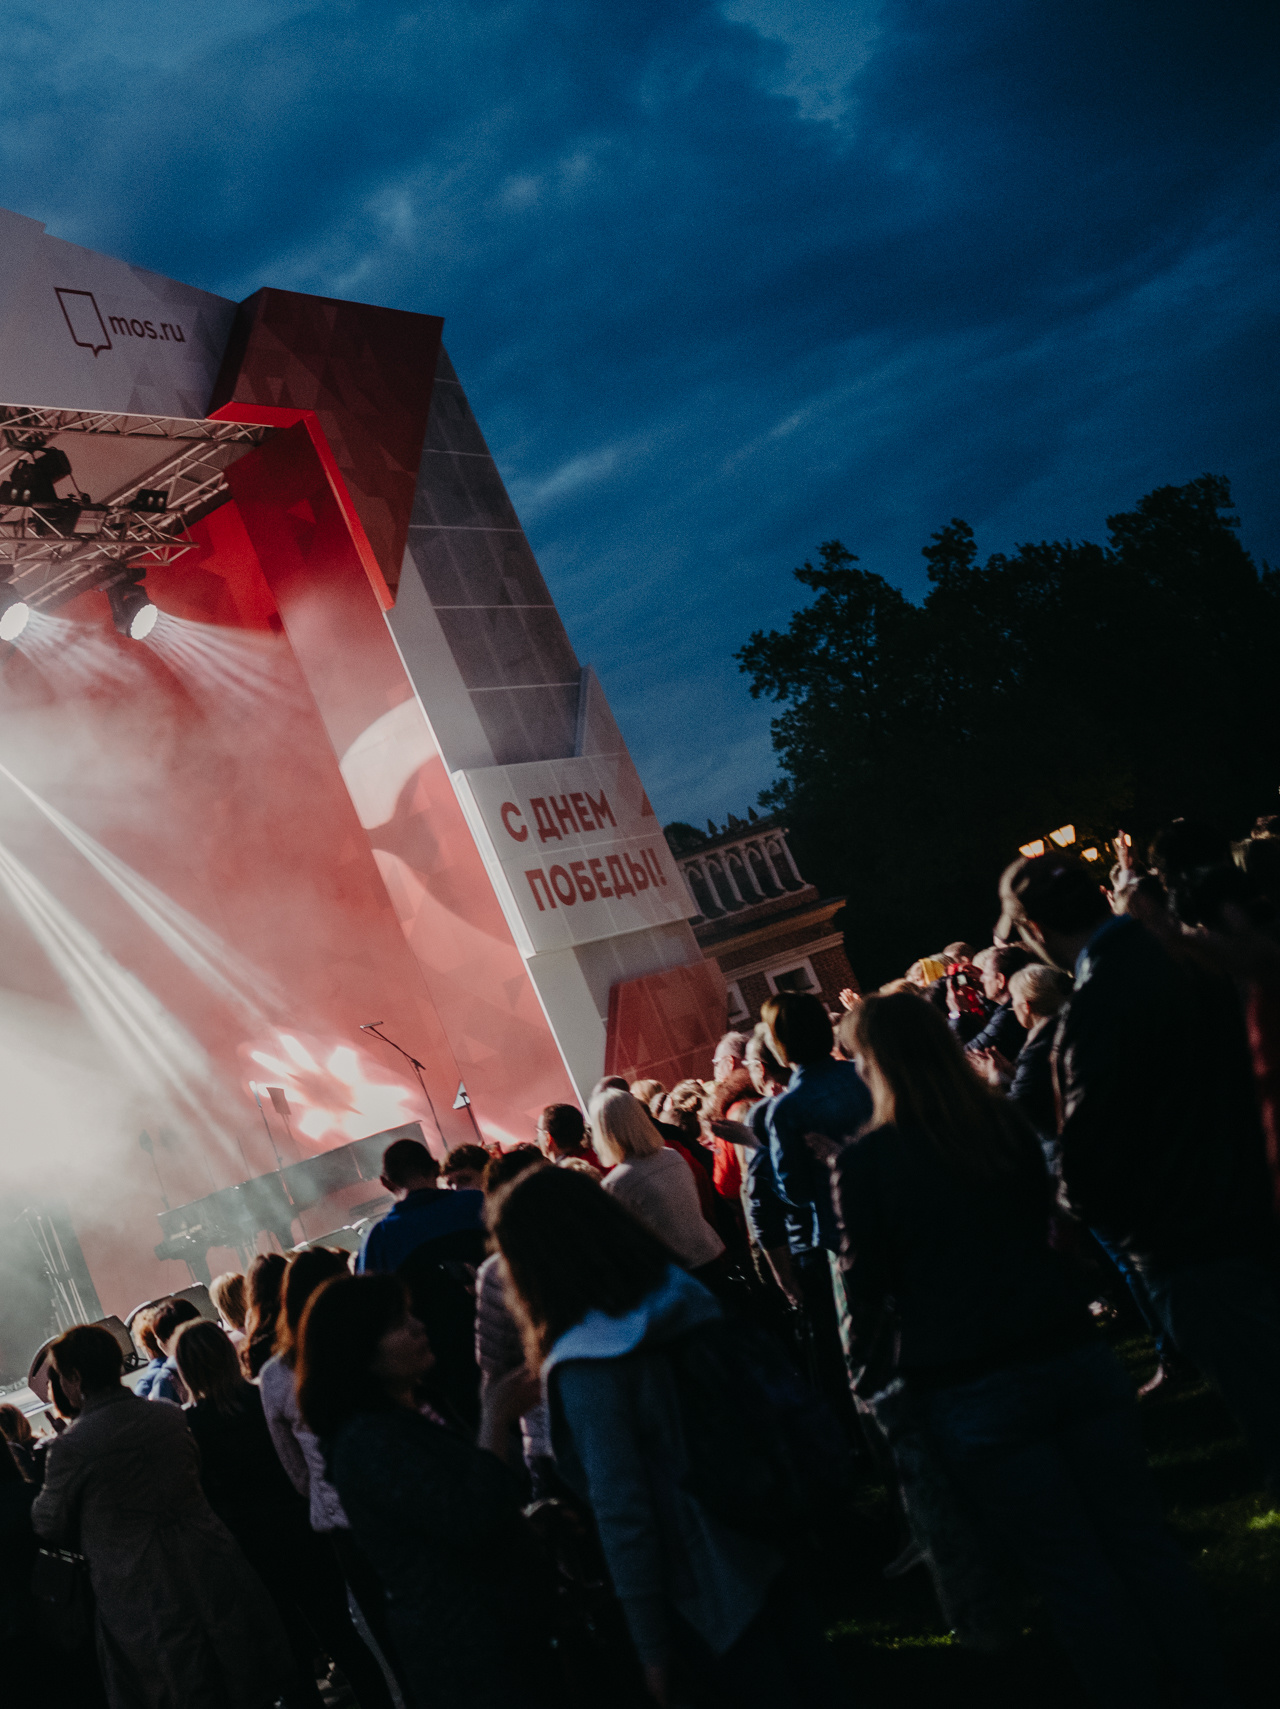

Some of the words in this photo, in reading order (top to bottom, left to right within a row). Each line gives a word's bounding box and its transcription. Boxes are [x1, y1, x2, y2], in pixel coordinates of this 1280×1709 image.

[108, 315, 186, 343] mos.ru
[500, 801, 529, 843] С
[529, 789, 618, 844] ДНЕМ
[524, 847, 668, 912] ПОБЕДЫ!
